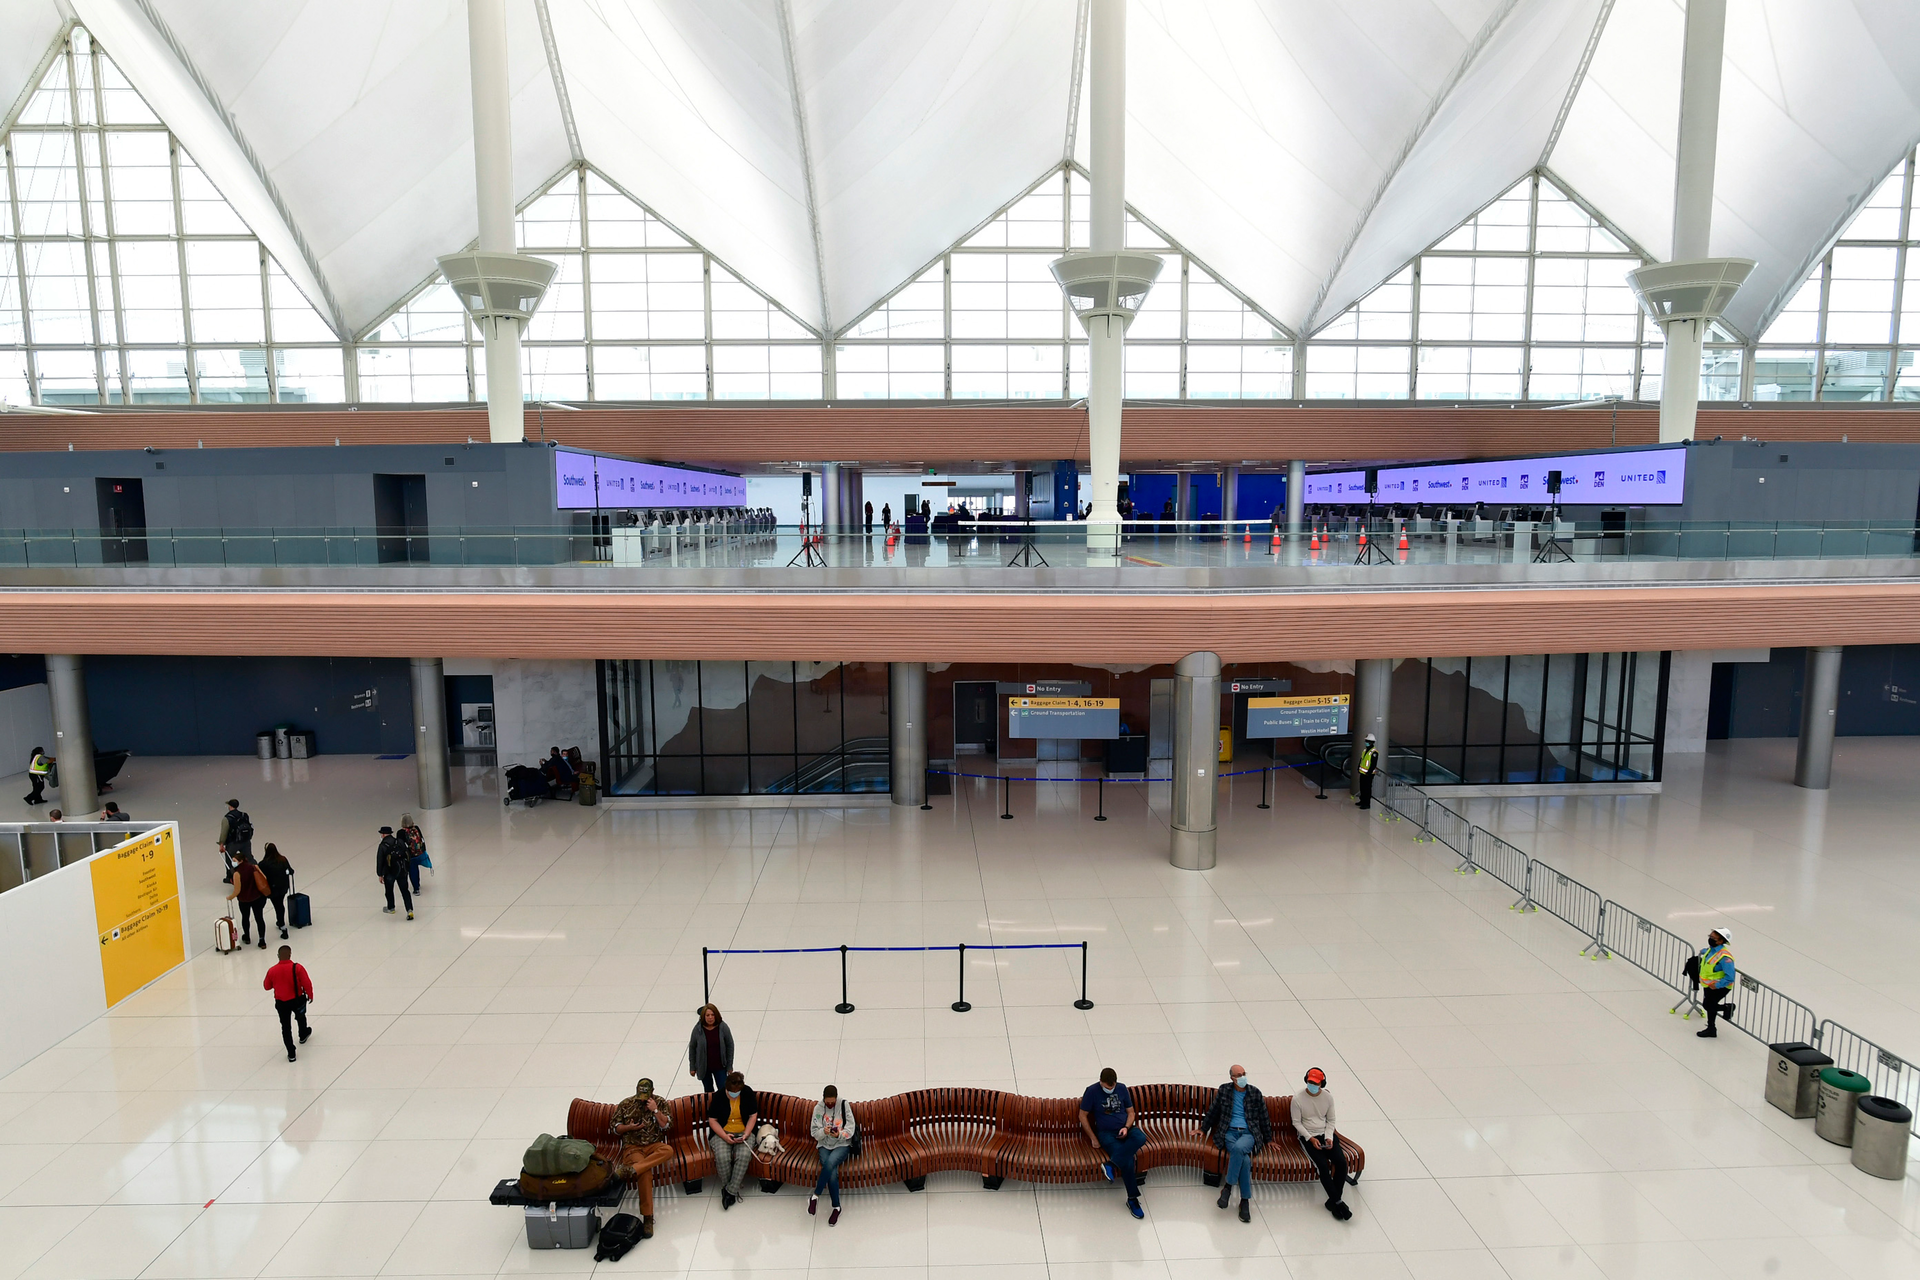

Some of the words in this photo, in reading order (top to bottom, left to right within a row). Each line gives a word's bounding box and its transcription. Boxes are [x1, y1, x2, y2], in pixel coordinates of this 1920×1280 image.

[563, 474, 586, 486] Southwest
[1542, 474, 1579, 486] Sowest
[1620, 473, 1655, 482] UNITED
[1428, 480, 1452, 489] Southwest
[117, 846, 138, 859] Baggage
[139, 840, 153, 850] Claim
[141, 850, 154, 862] 1-9
[120, 919, 141, 933] Baggage
[141, 911, 155, 922] Claim
[156, 904, 169, 914] 10-19
